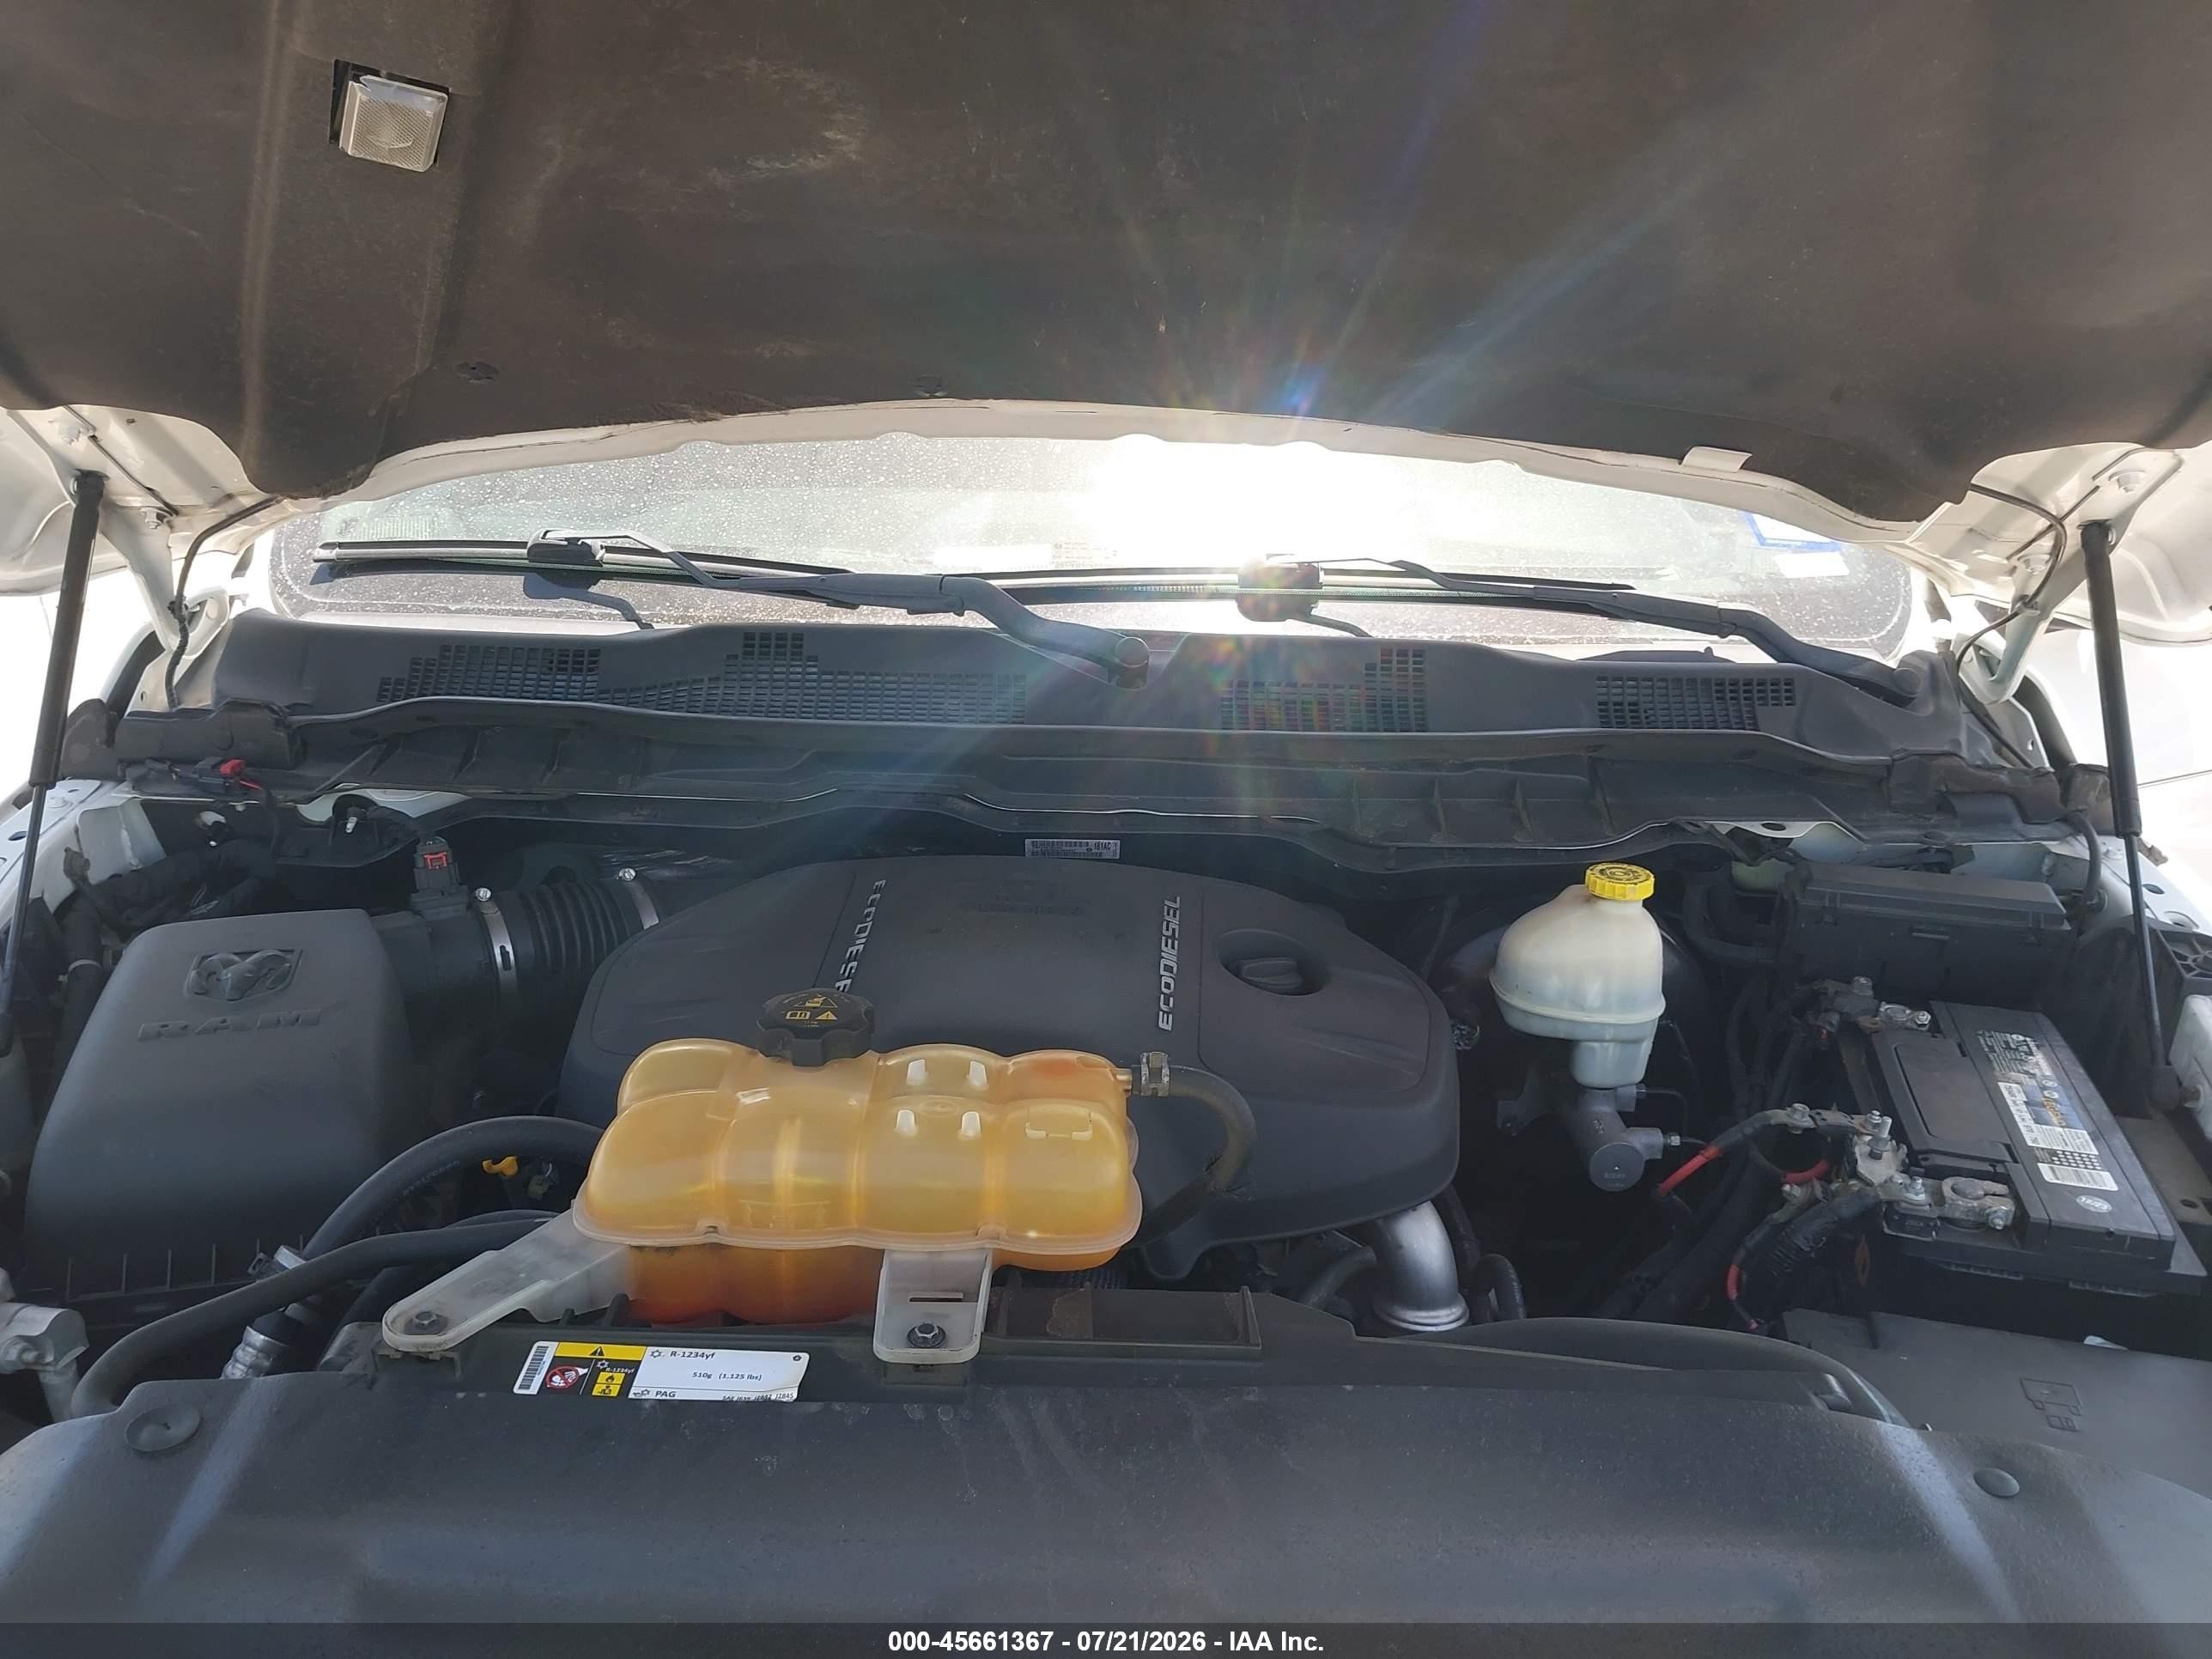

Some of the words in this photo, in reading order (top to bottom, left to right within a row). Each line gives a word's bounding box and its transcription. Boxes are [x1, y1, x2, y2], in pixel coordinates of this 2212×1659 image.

[835, 879, 886, 993] ECODIESE
[1158, 896, 1181, 1031] ECODIESEL
[137, 1009, 322, 1042] RAM
[669, 1350, 716, 1360] R-1234yf
[655, 1390, 677, 1399] PAG
